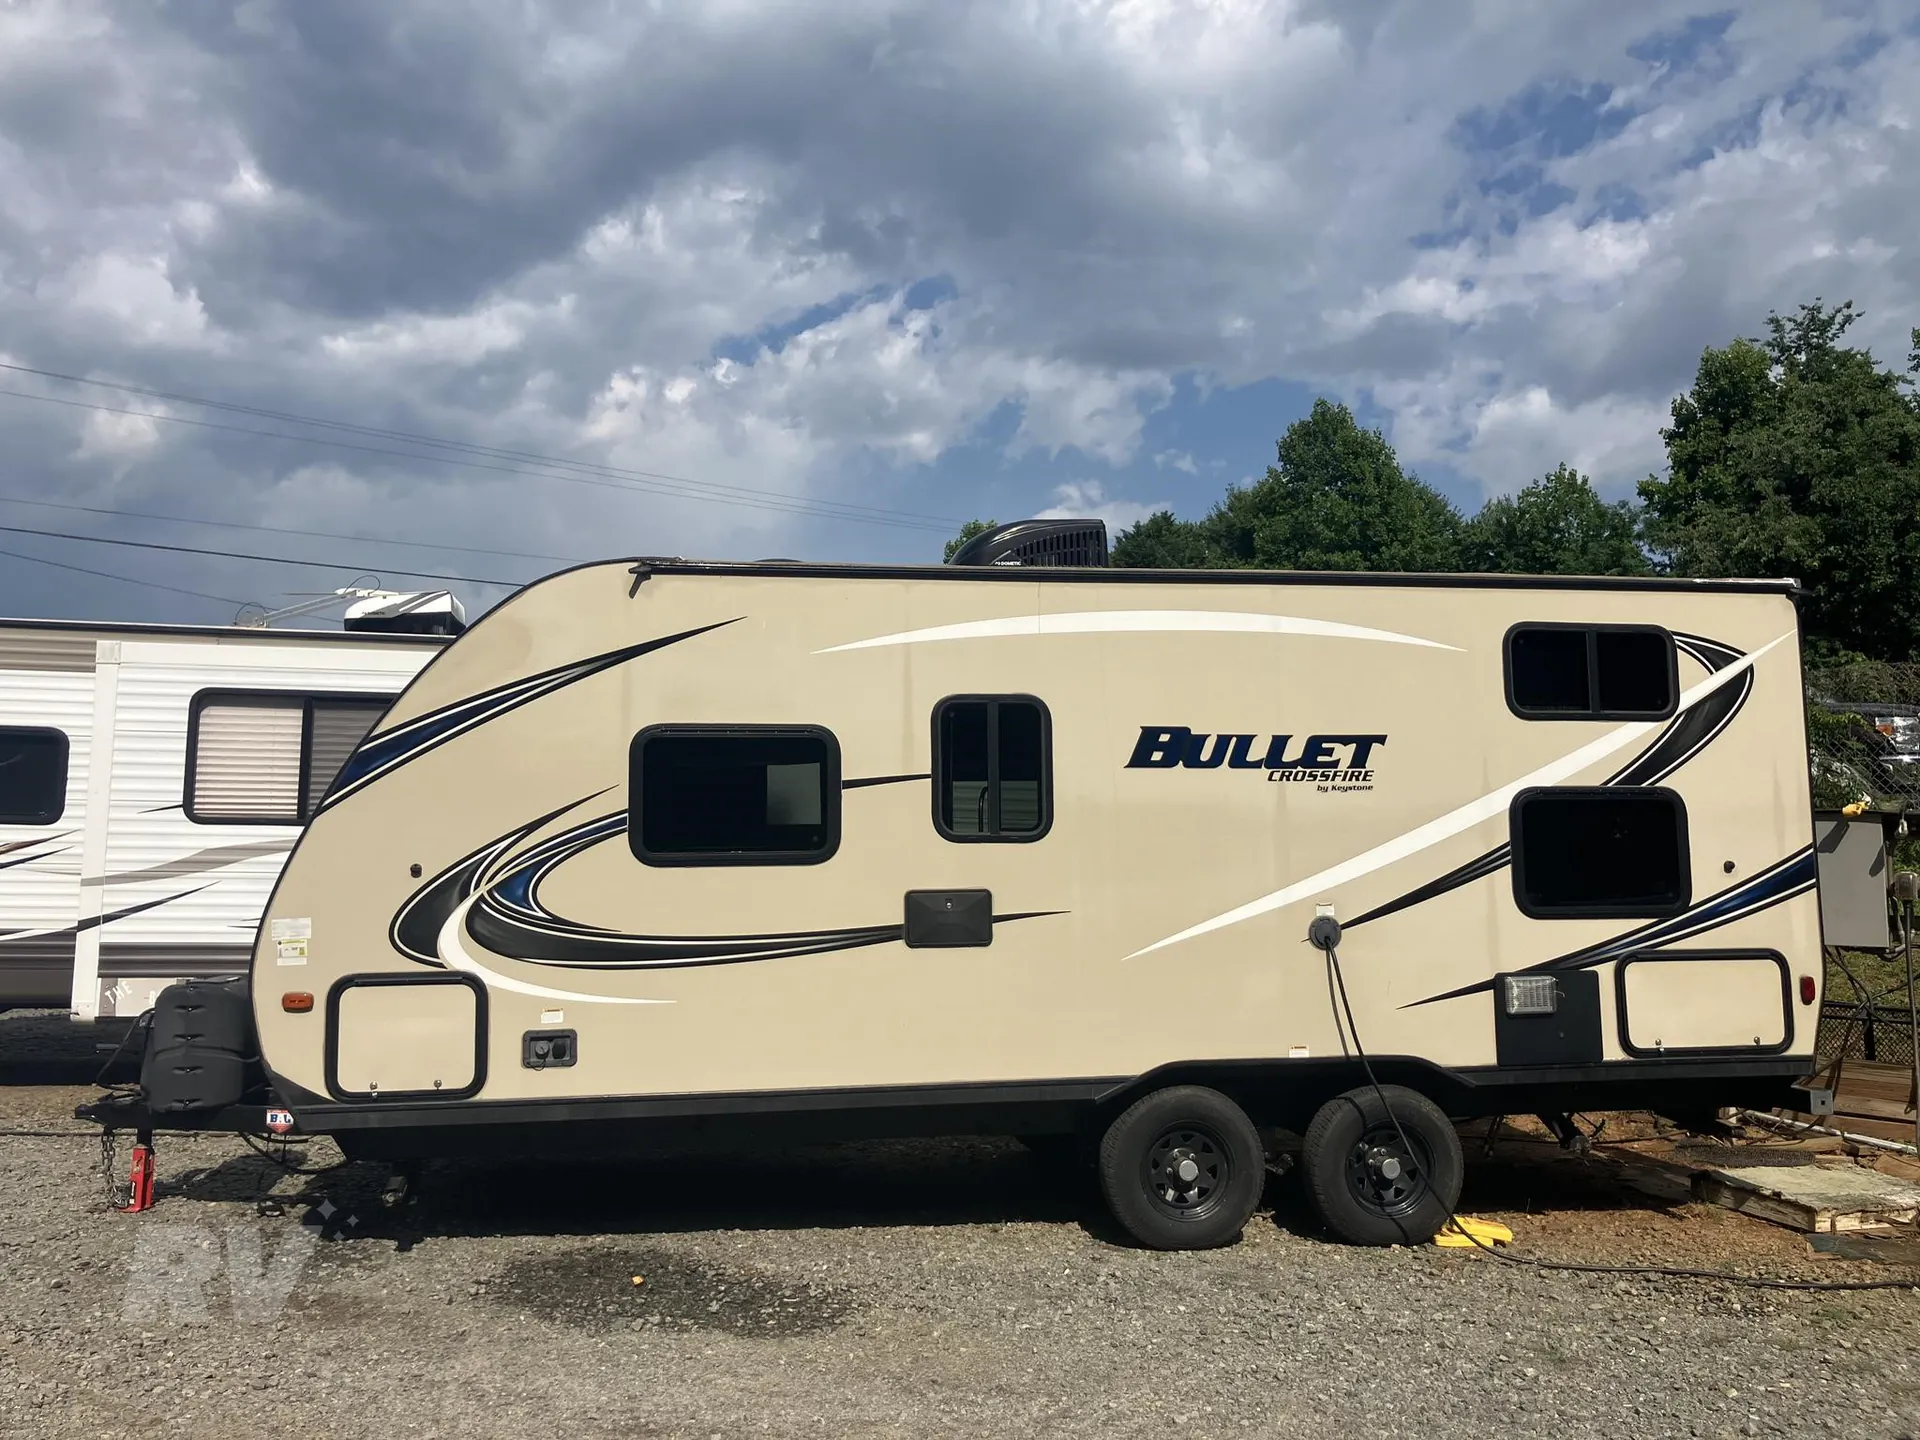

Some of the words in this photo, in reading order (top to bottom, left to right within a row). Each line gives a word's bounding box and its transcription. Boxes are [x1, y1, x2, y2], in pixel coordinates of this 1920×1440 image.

[1123, 725, 1388, 769] BULLET
[1267, 769, 1375, 782] CROSSFIRE
[1316, 784, 1329, 792] by
[1331, 784, 1374, 793] Keystone
